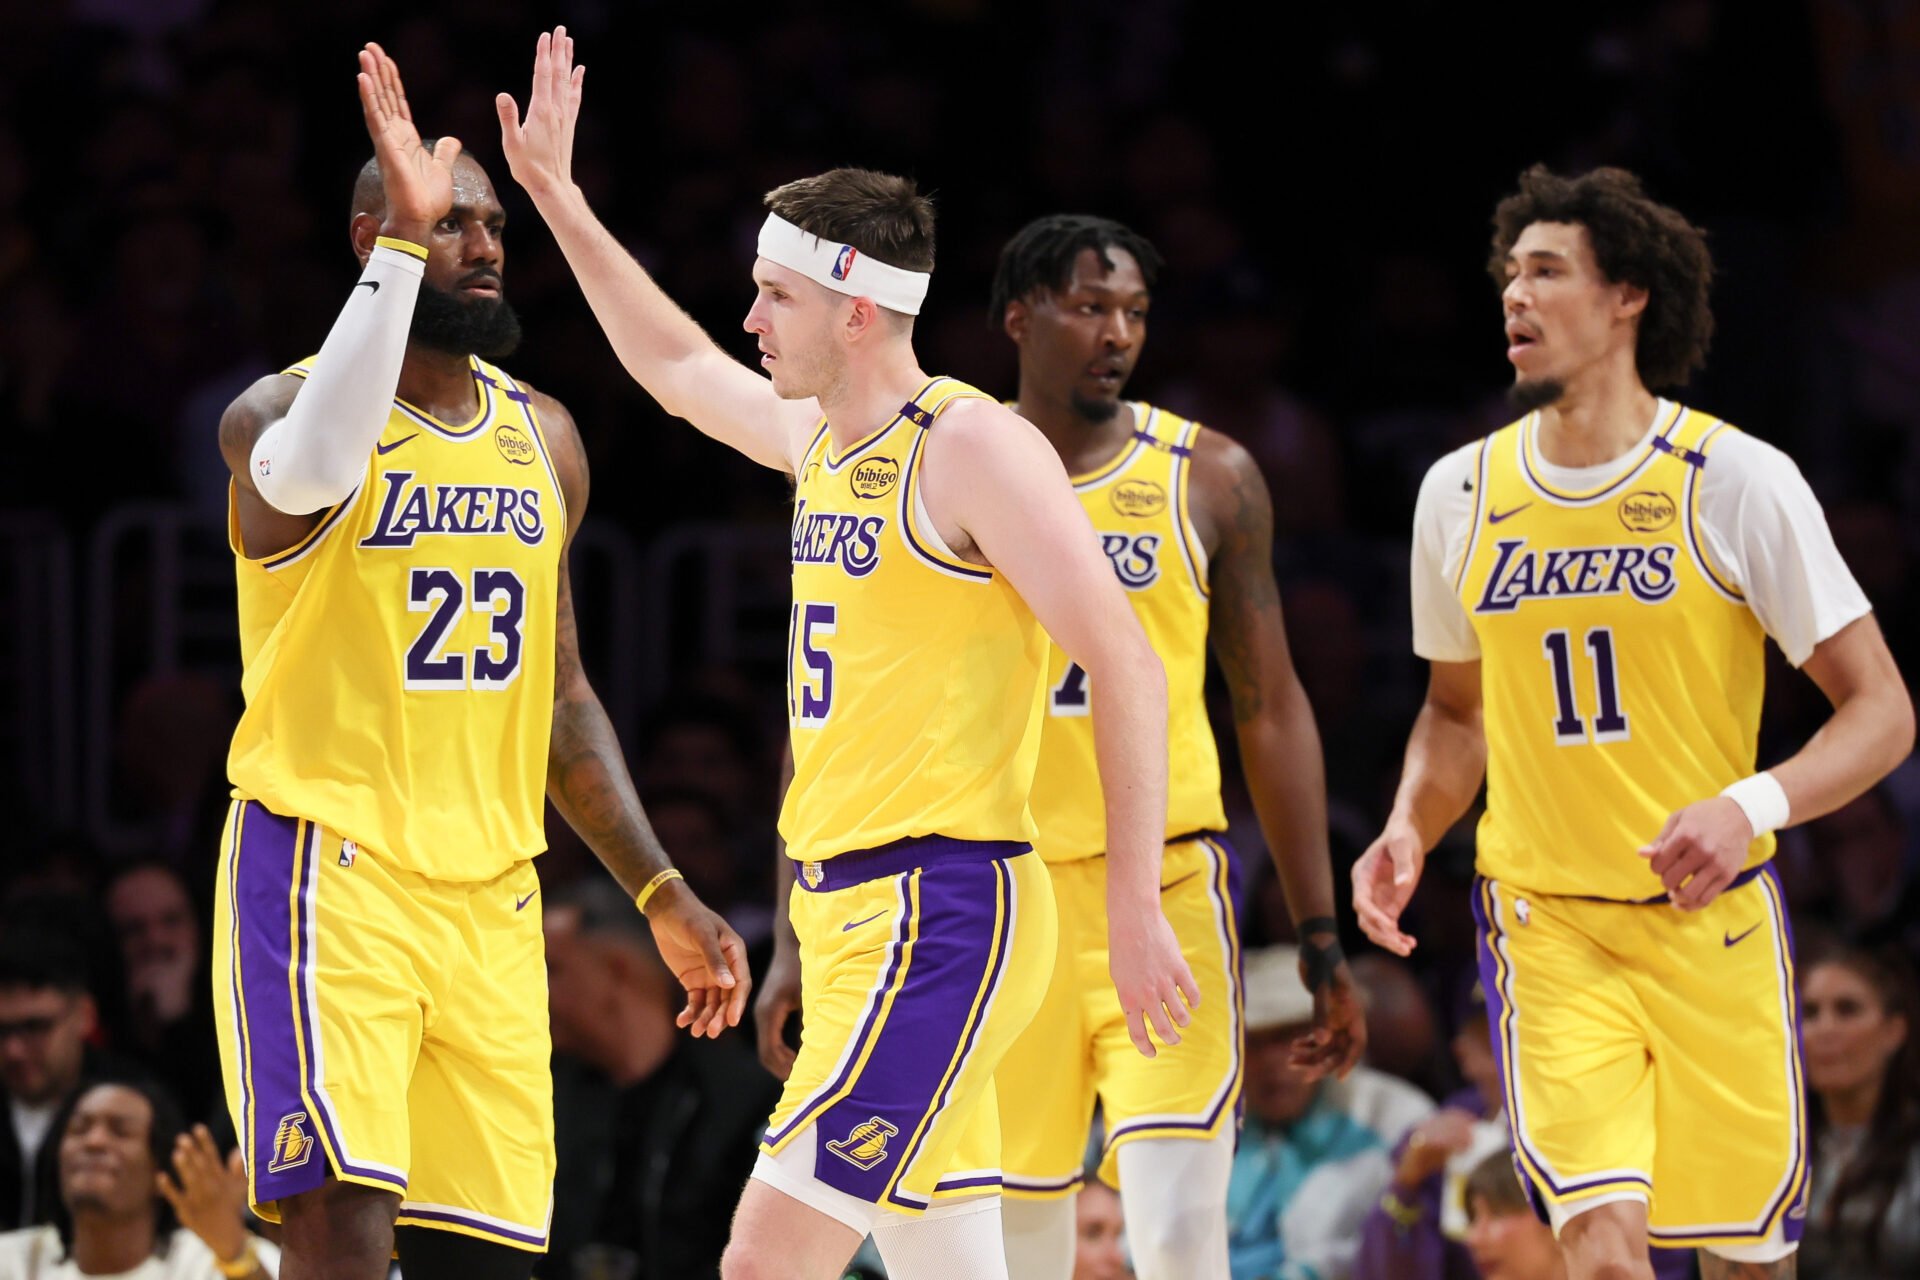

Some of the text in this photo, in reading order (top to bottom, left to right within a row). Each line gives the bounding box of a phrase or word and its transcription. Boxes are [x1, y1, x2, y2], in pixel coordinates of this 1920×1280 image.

[497, 434, 532, 455] bibigo
[855, 467, 897, 488] bibigo
[358, 470, 546, 549] LAKERS
[1624, 501, 1672, 520] bibigo
[1474, 538, 1680, 614] LAKERS
[404, 567, 527, 691] 23
[1543, 625, 1631, 746] 11
